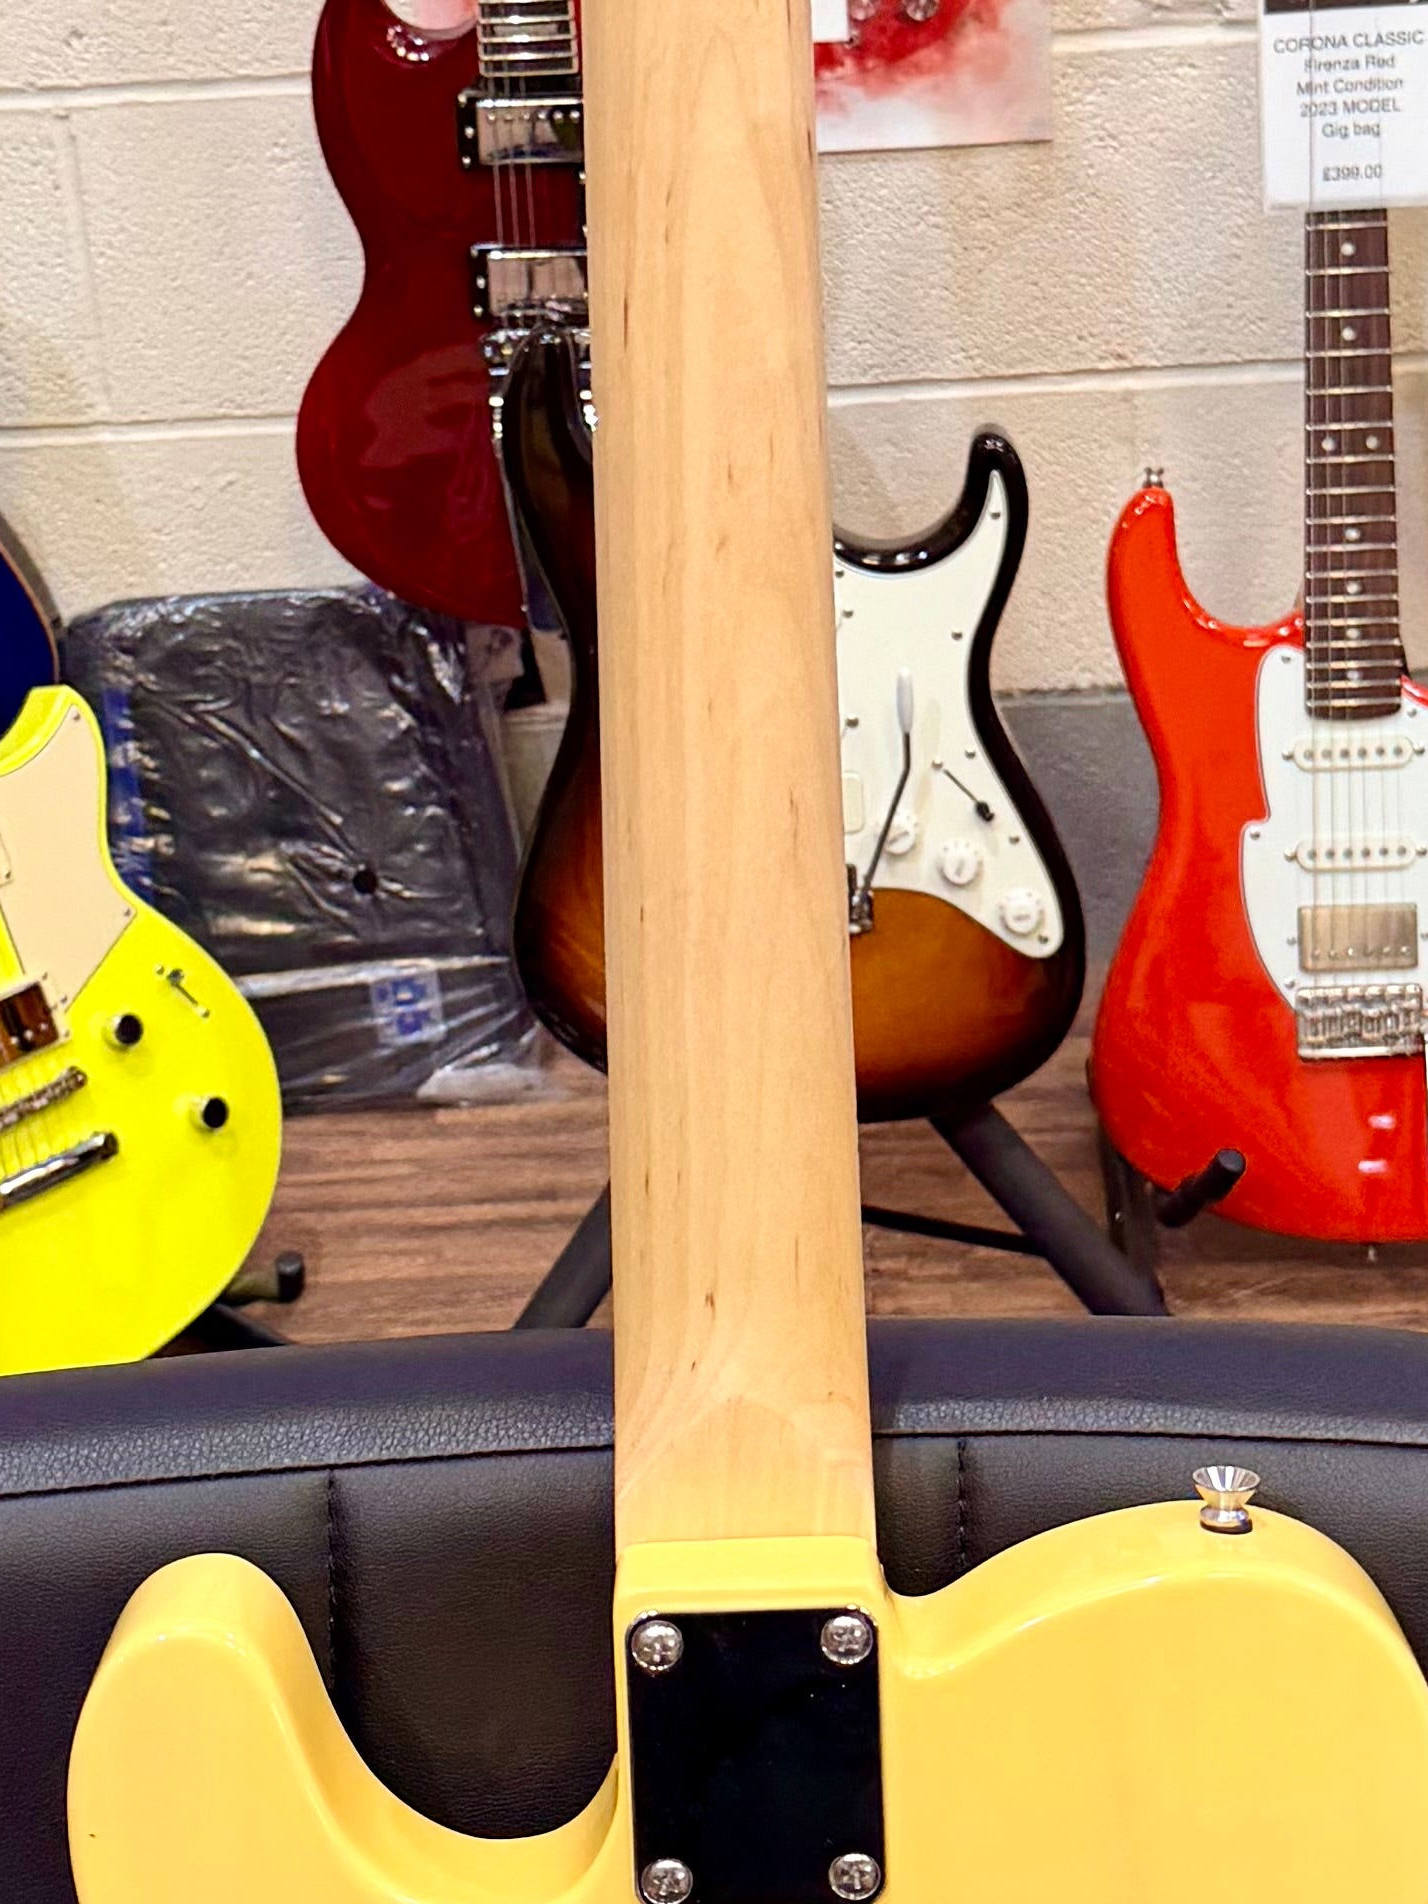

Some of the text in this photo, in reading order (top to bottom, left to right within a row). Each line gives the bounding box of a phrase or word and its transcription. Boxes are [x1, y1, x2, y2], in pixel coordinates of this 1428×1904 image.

[1274, 30, 1425, 54] CORONA CLASSIC
[1303, 53, 1396, 73] Firenza Red
[1296, 77, 1404, 97] Mint Condition
[1342, 98, 1401, 116] MODEL
[1322, 121, 1381, 139] Gig bag
